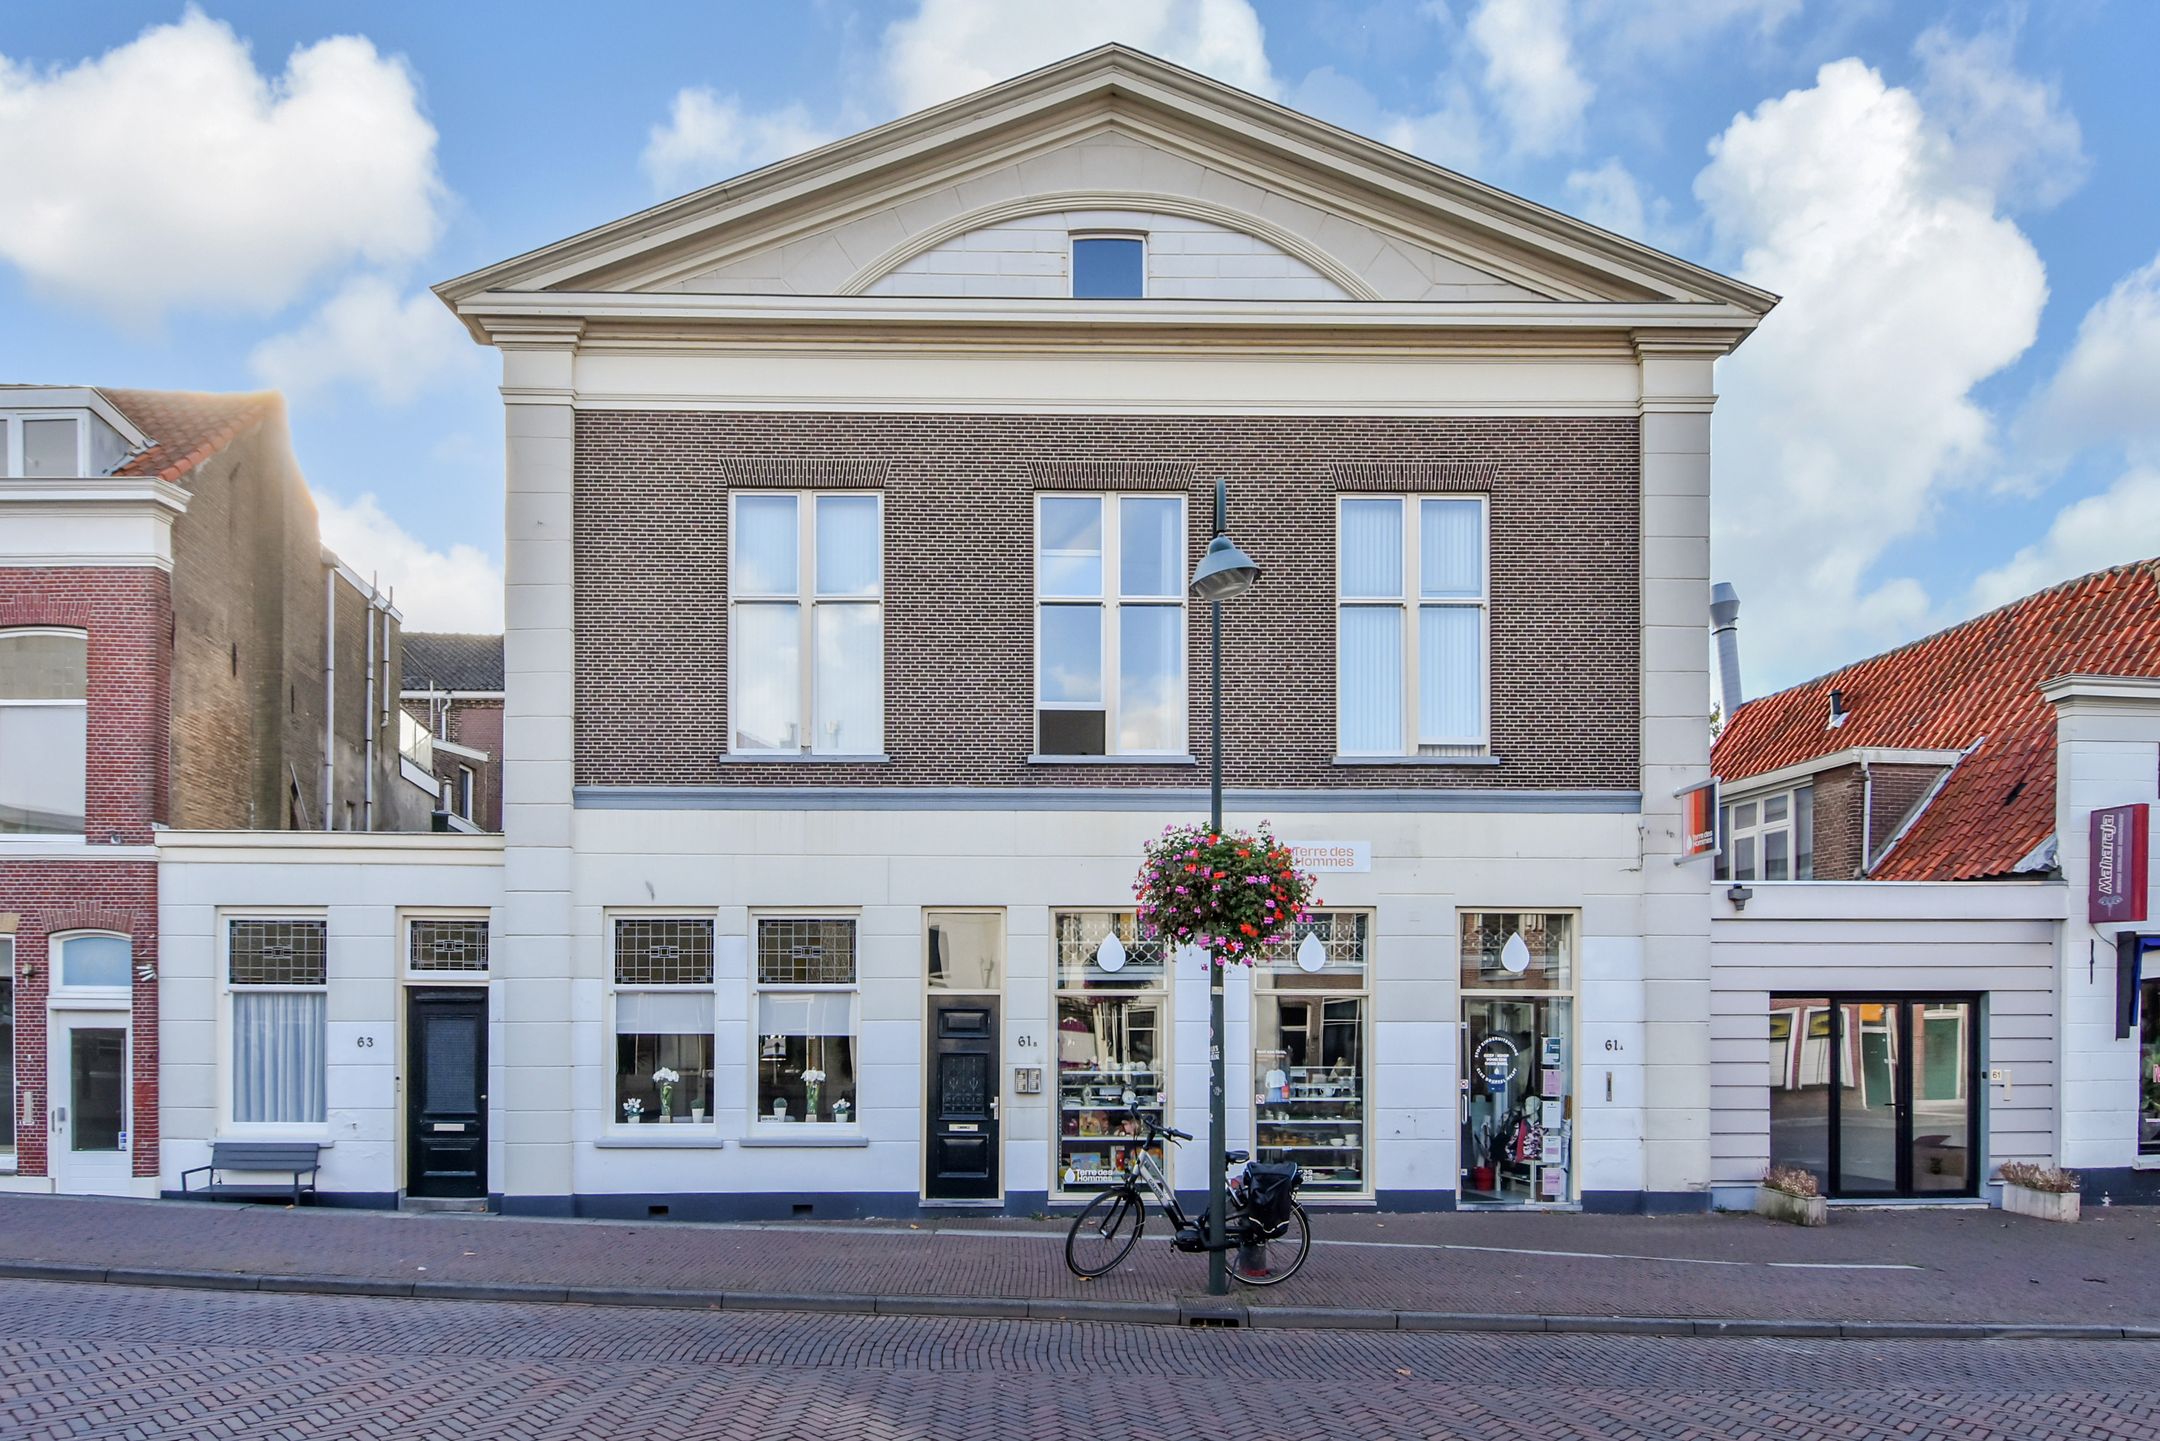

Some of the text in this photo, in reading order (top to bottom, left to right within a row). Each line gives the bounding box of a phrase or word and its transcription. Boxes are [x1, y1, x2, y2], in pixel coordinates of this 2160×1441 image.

[1293, 846, 1354, 857] Terre des
[2098, 814, 2116, 894] Maharaja
[357, 1036, 374, 1048] 63
[1992, 1071, 2001, 1079] 61
